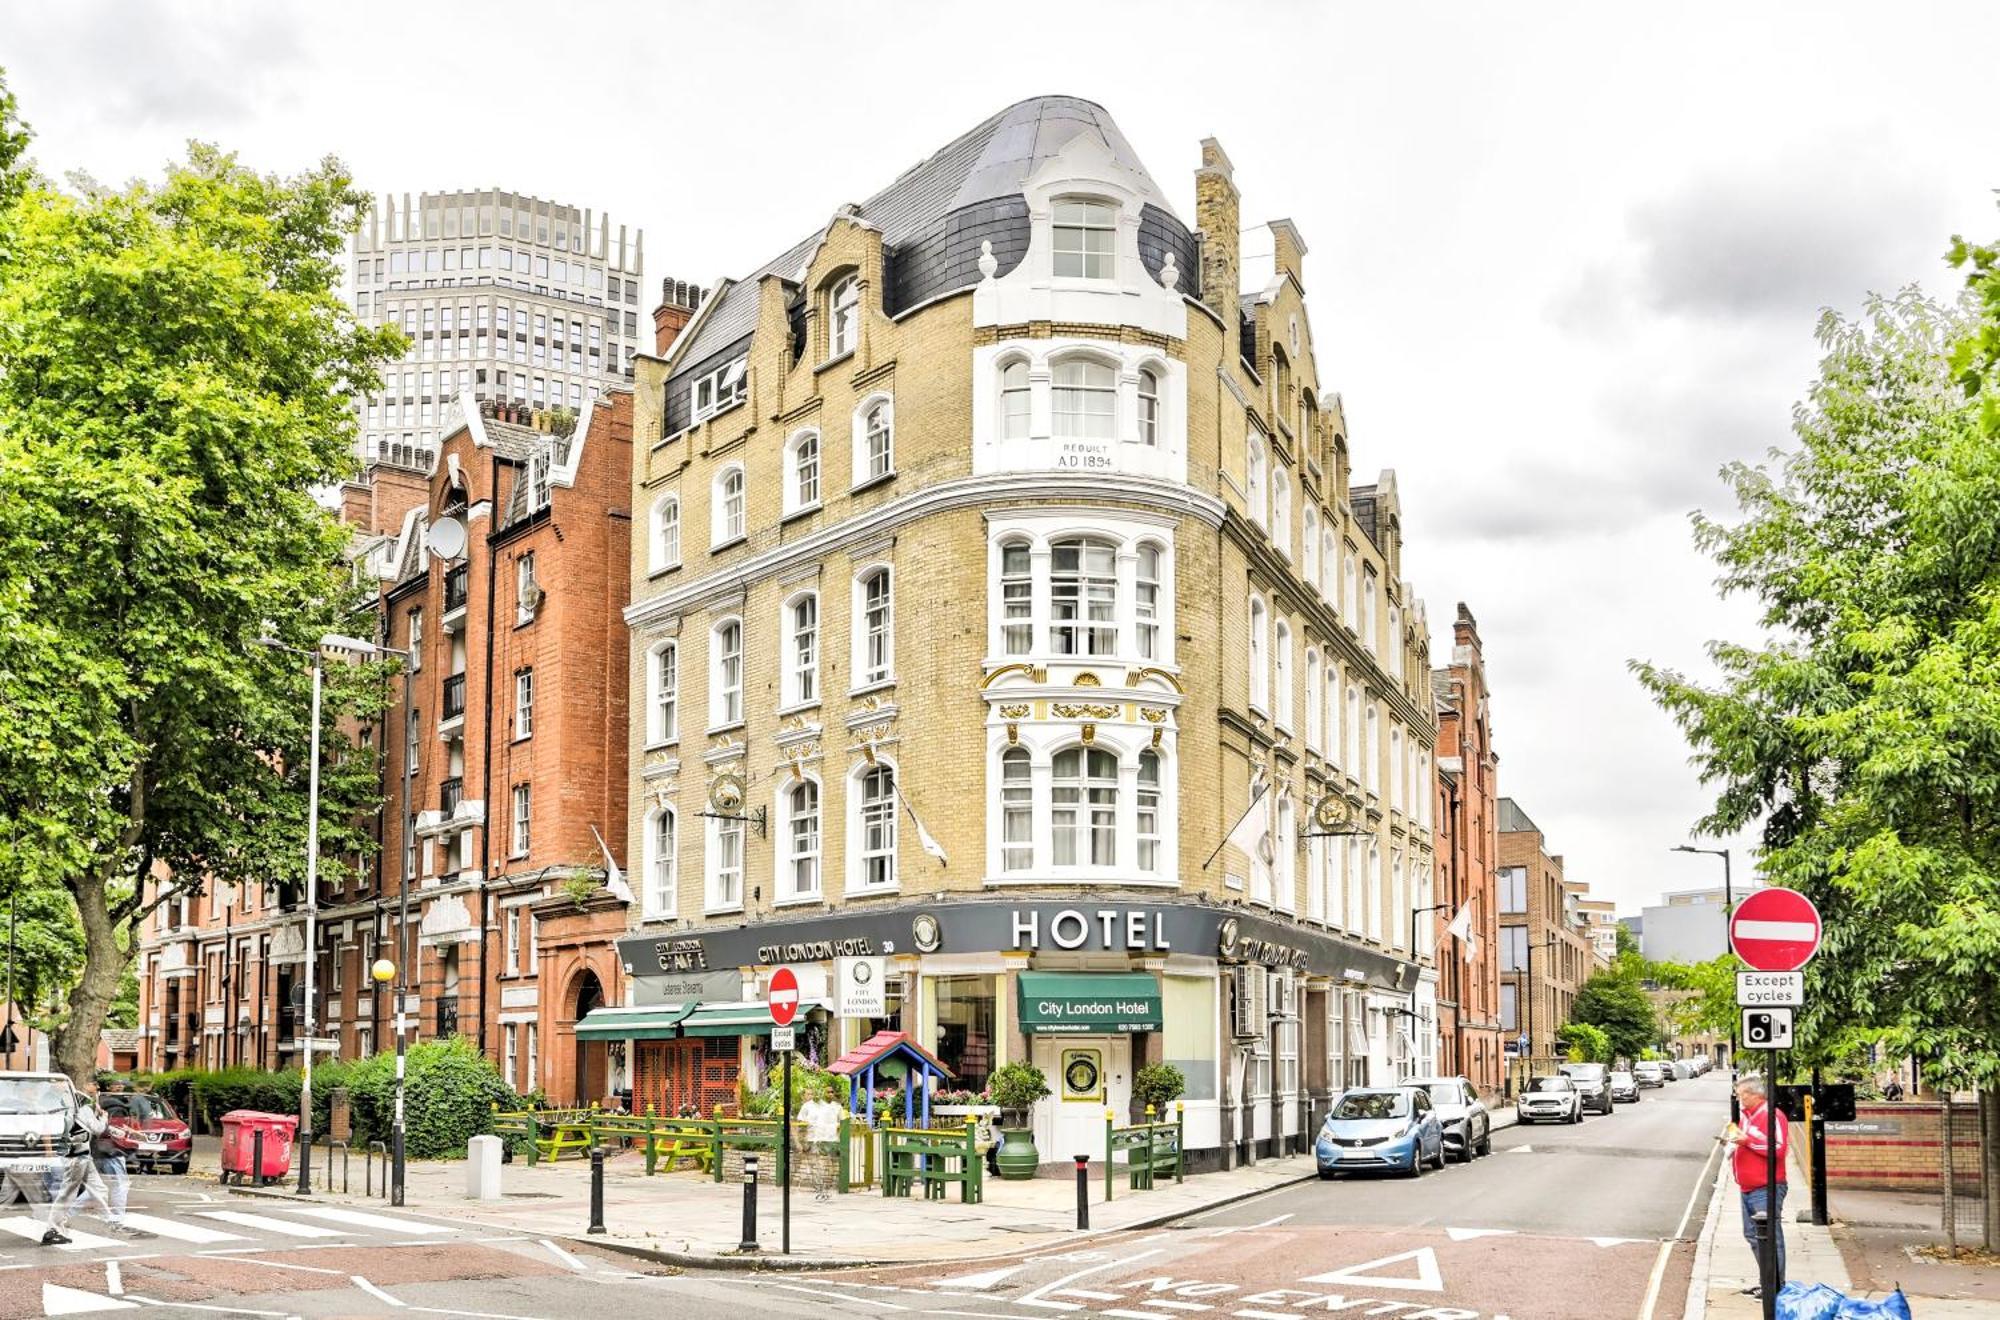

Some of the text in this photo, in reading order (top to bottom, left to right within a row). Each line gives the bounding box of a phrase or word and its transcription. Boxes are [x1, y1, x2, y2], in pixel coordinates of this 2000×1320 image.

[1063, 443, 1108, 453] REBUILT
[1083, 455, 1111, 467] 1894
[1012, 909, 1170, 949] HOTEL
[758, 938, 874, 962] CITY LONDON HOTEL
[882, 940, 895, 953] 30
[1744, 974, 1795, 988] Except
[1747, 989, 1793, 1003] cycles
[1038, 1001, 1149, 1018] City London Hotel
[1117, 1277, 1240, 1296] NO
[1237, 1289, 1509, 1320] ENTR
